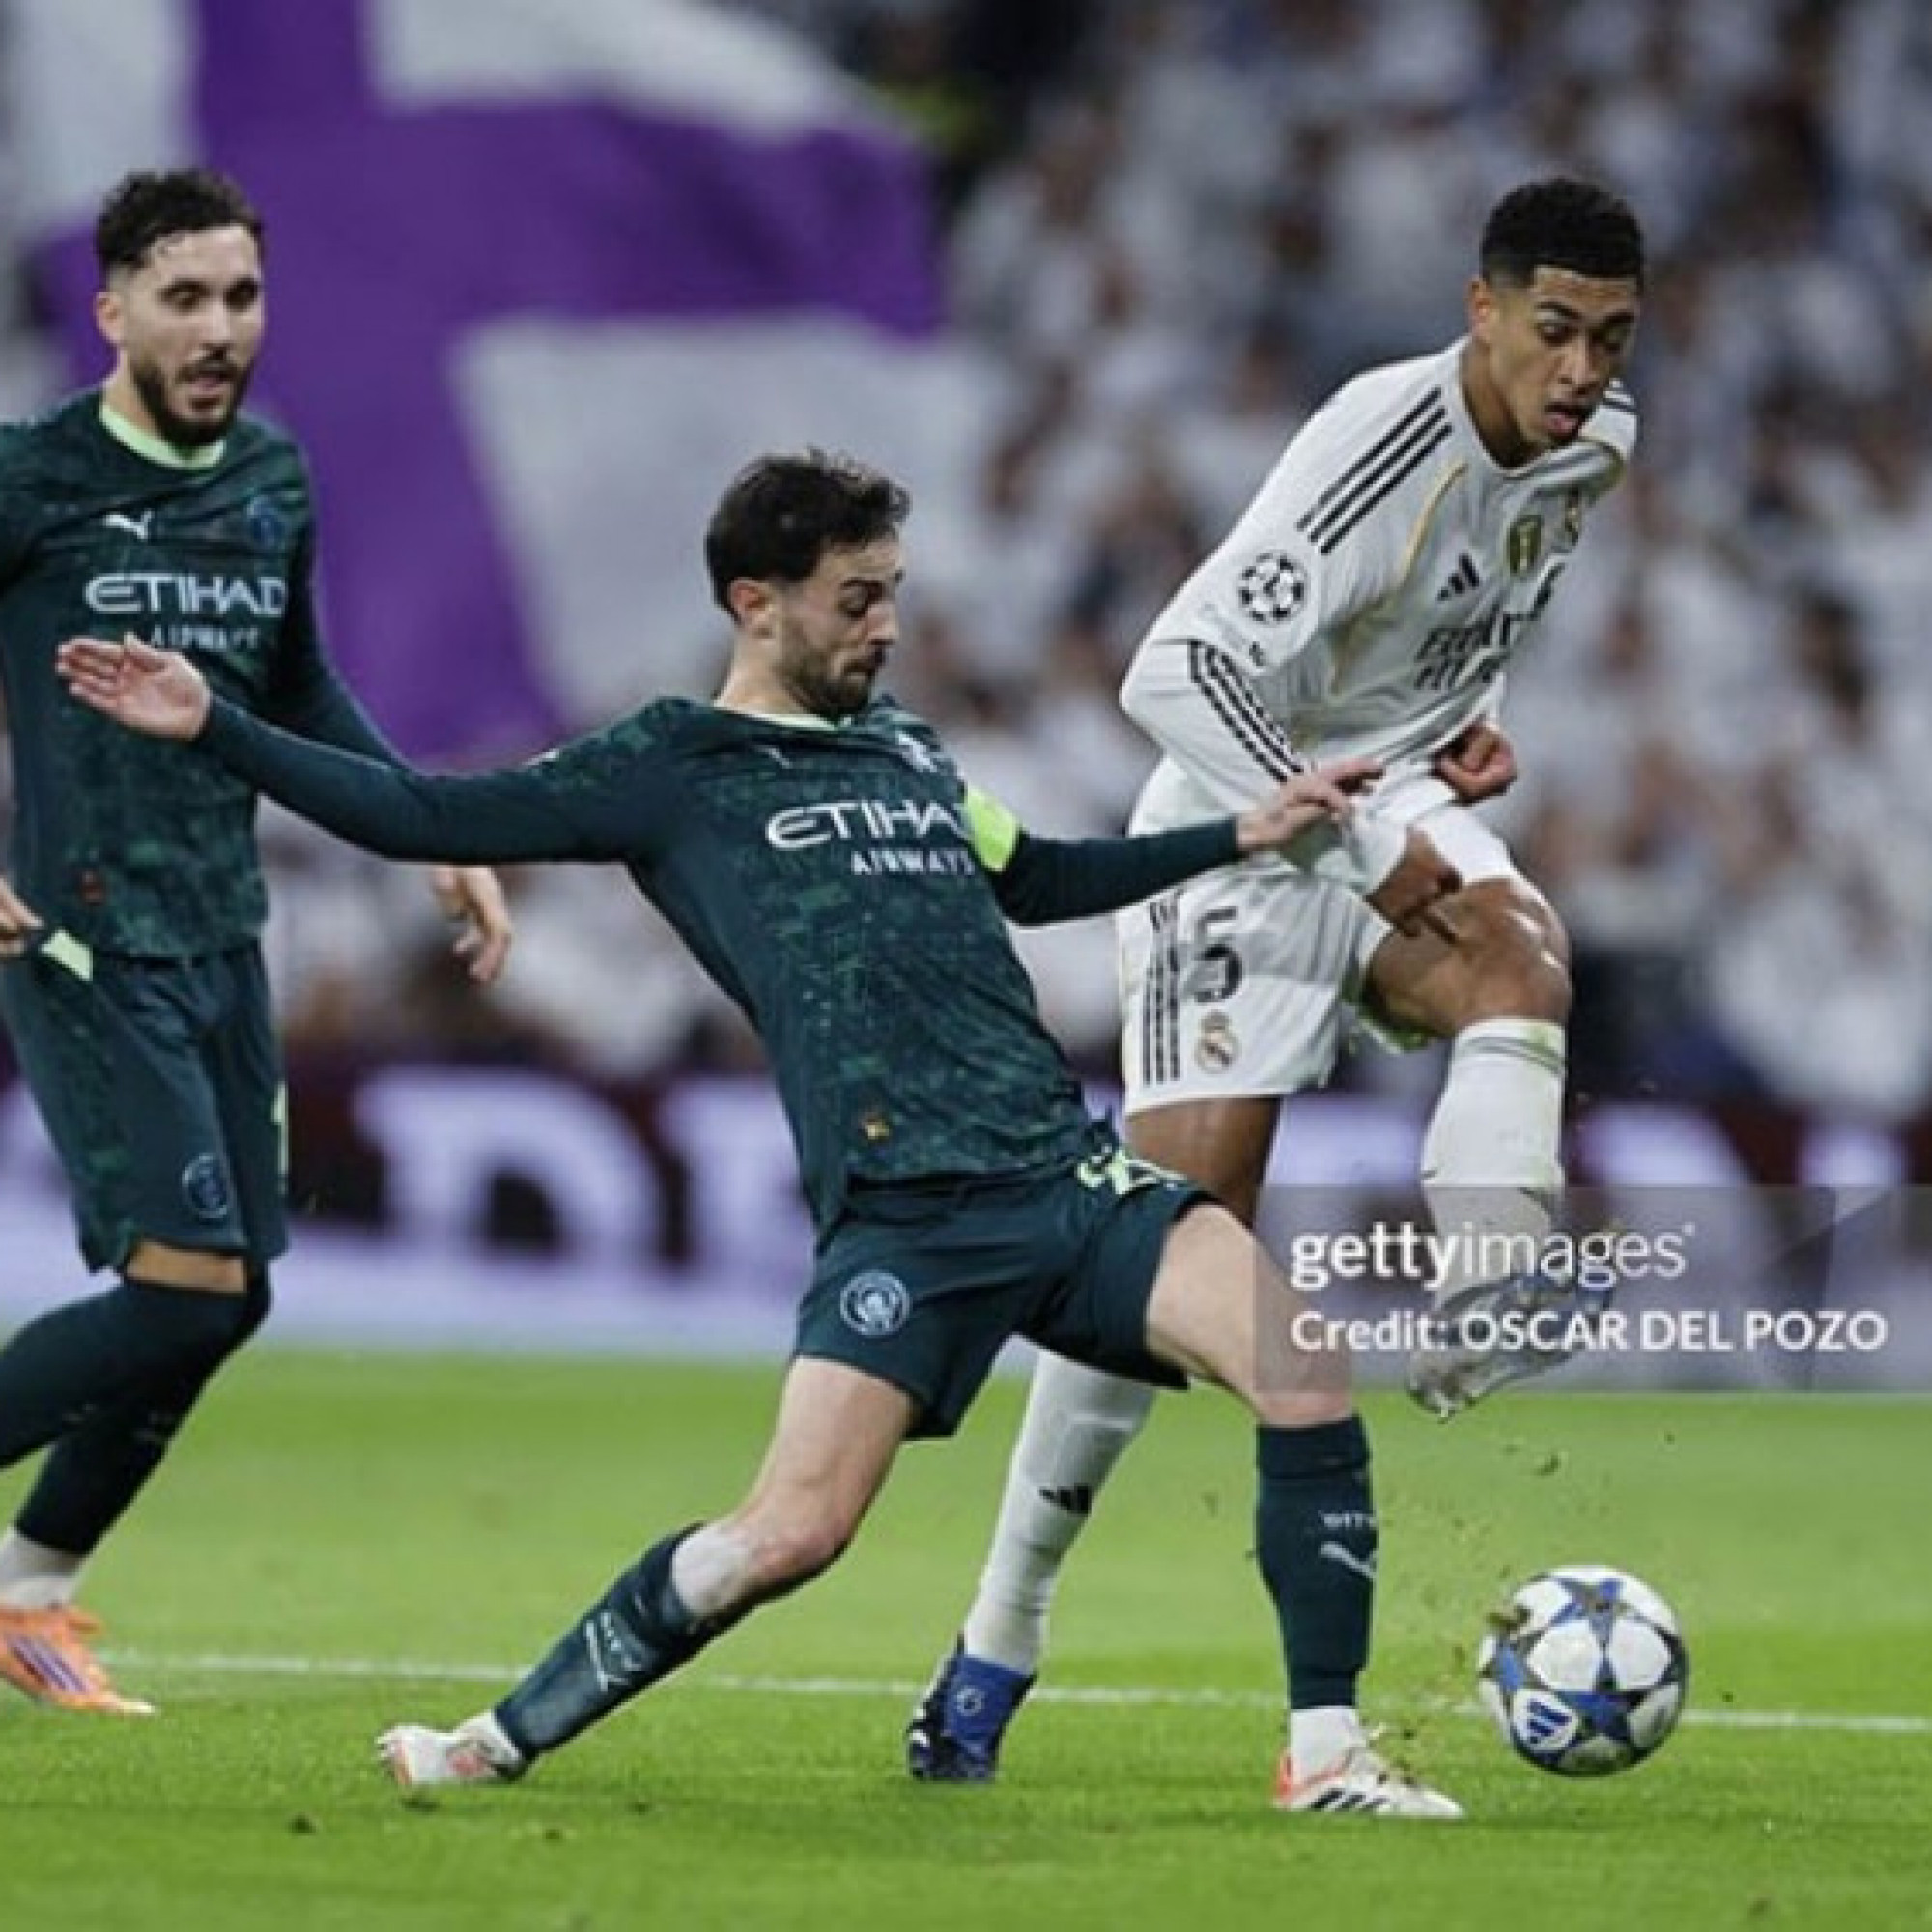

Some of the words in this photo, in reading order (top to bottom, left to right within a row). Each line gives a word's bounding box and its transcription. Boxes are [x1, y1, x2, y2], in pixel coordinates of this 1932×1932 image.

[84, 572, 288, 618] ETIHAD
[765, 799, 969, 850] ETIHA
[1194, 905, 1243, 1003] 5
